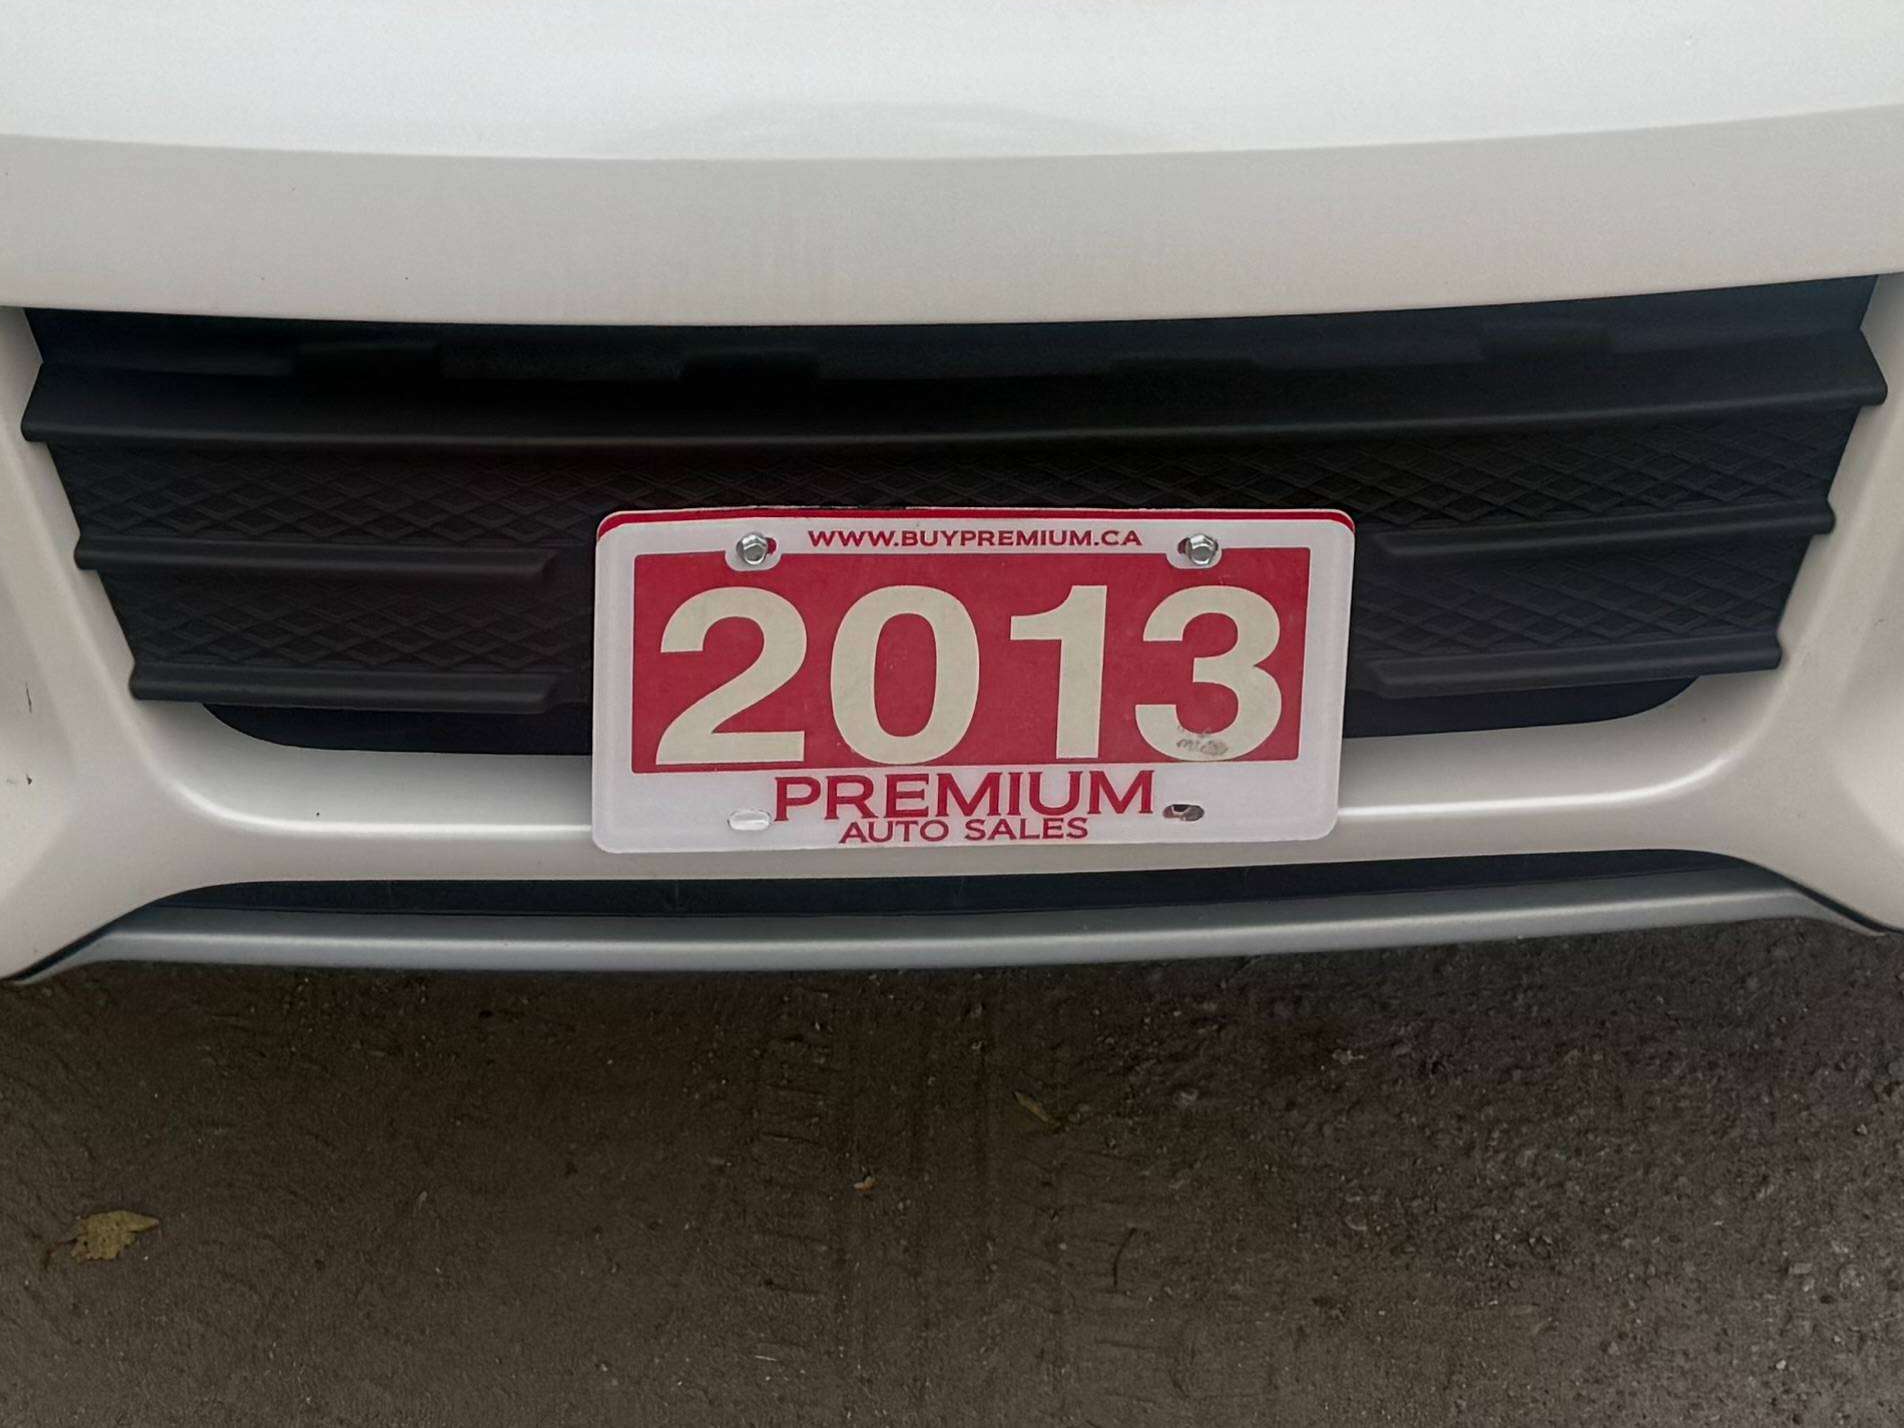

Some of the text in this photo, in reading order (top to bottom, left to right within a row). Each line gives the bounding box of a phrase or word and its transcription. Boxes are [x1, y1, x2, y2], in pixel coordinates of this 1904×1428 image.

[807, 529, 1143, 548] WWW.BUYPREMIUM.CA
[655, 584, 1284, 766] 2013
[773, 769, 1155, 823] PREMIUM
[838, 816, 1089, 844] AUTO SALES
